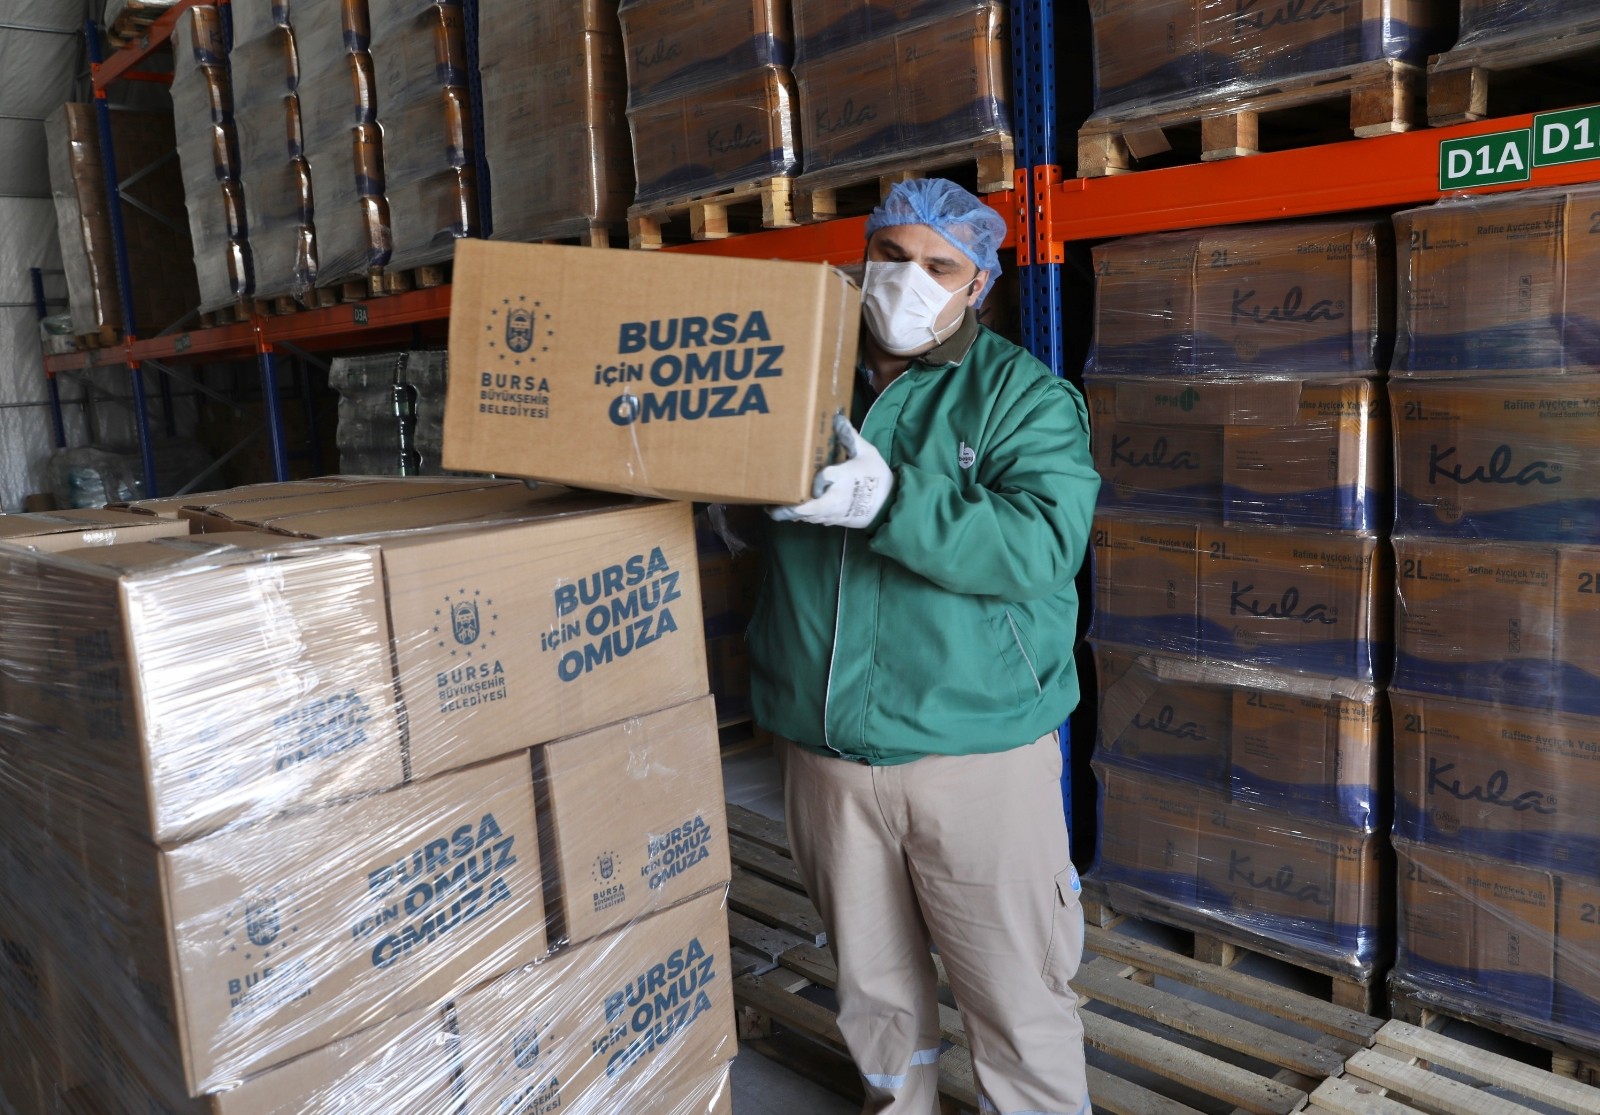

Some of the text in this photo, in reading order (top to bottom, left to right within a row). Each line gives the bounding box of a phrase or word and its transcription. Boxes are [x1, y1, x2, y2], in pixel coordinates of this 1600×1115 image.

[634, 38, 682, 73] Kula
[815, 100, 877, 138] Kula
[1542, 117, 1600, 155] D1
[706, 122, 763, 158] Kula
[1447, 141, 1524, 179] D1A
[1410, 229, 1433, 250] 2L
[1477, 225, 1504, 235] Rafine
[1230, 286, 1344, 326] Kula
[618, 310, 772, 354] BURSA
[481, 372, 550, 393] BURSA
[650, 345, 785, 388] OMUZ
[479, 403, 549, 419] BELEDİYESİ
[608, 383, 770, 427] OMUZA
[1405, 401, 1428, 421] 2L
[1504, 400, 1535, 410] Rafine
[1110, 433, 1199, 471] Kula
[1428, 444, 1562, 485] Kula
[1095, 531, 1113, 548] 2L
[1210, 541, 1231, 560] 2L
[1293, 550, 1318, 560] Rafine
[554, 546, 670, 618] BURSA
[1404, 559, 1427, 580] 2L
[1468, 566, 1493, 576] Rafine
[1495, 567, 1528, 579] Ayçiçek
[585, 571, 682, 637] OMUZ
[1230, 581, 1337, 624] Kula
[557, 607, 678, 683] OMUZA
[437, 660, 504, 687] BURSA
[1246, 691, 1267, 708] 2L
[1131, 704, 1207, 741] ula
[1405, 713, 1427, 733] 2L
[1501, 729, 1532, 743] Rafine
[1427, 757, 1557, 814] Kula
[368, 812, 503, 898] BURSA
[647, 815, 706, 859] BURSA
[662, 825, 712, 866] OMUZ
[404, 835, 517, 918] OMUZ
[648, 845, 710, 889] OMUZA
[1228, 849, 1332, 906] Kula
[1407, 861, 1428, 883] 2L
[1466, 876, 1491, 890] Rafine
[593, 883, 625, 901] BURSA
[371, 875, 513, 969] OMUZA
[603, 937, 705, 1025] BURSA
[631, 954, 716, 1033] OMUZ
[606, 990, 712, 1079] OMUZA
